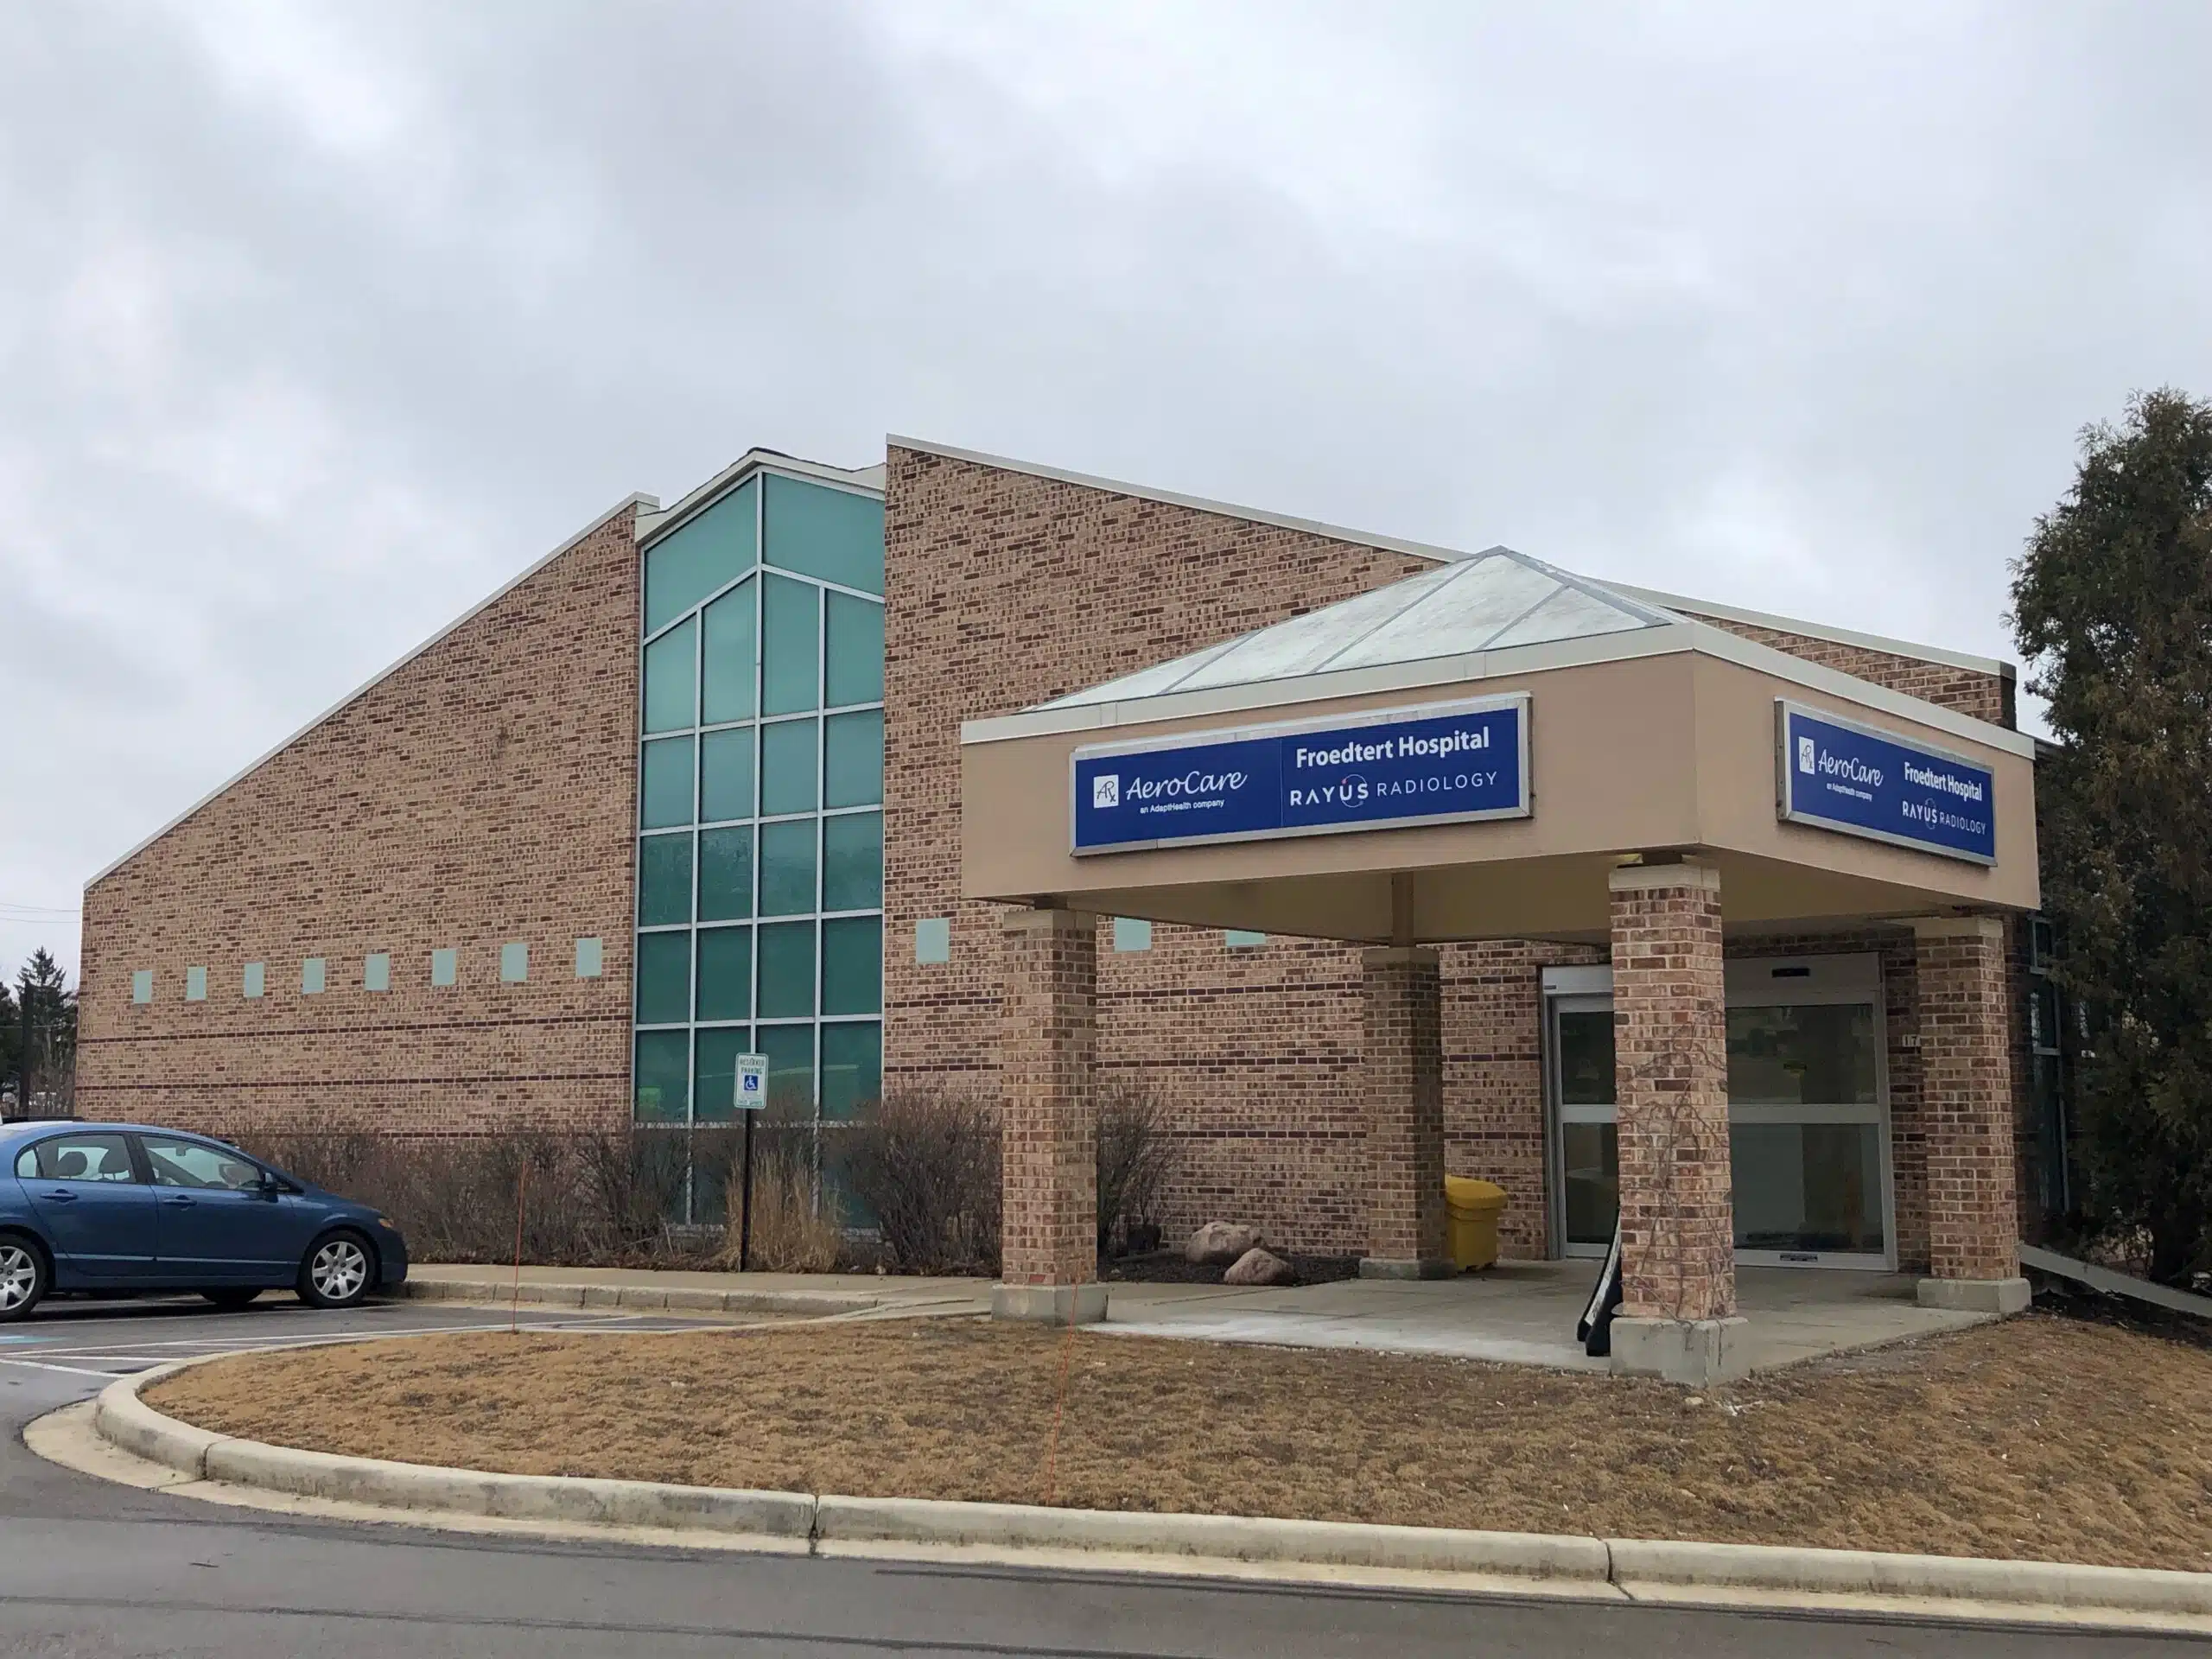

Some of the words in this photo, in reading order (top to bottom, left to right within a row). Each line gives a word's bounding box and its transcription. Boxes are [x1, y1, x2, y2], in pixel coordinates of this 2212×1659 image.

[1296, 740, 1393, 768] Froedtert
[1399, 726, 1490, 758] Hospital
[1818, 748, 1884, 787] AeroCare
[1904, 761, 1947, 792] Froedtert
[1948, 774, 1982, 802] Hospital
[1126, 770, 1248, 801] AeroCare
[1290, 781, 1370, 806] RAYUS
[1376, 771, 1497, 797] RADIOLOGY
[1150, 800, 1192, 814] AdaptHealth
[1193, 798, 1224, 810] company
[1902, 800, 1937, 823] RAYUS
[1939, 811, 1986, 835] RADIOLOGY
